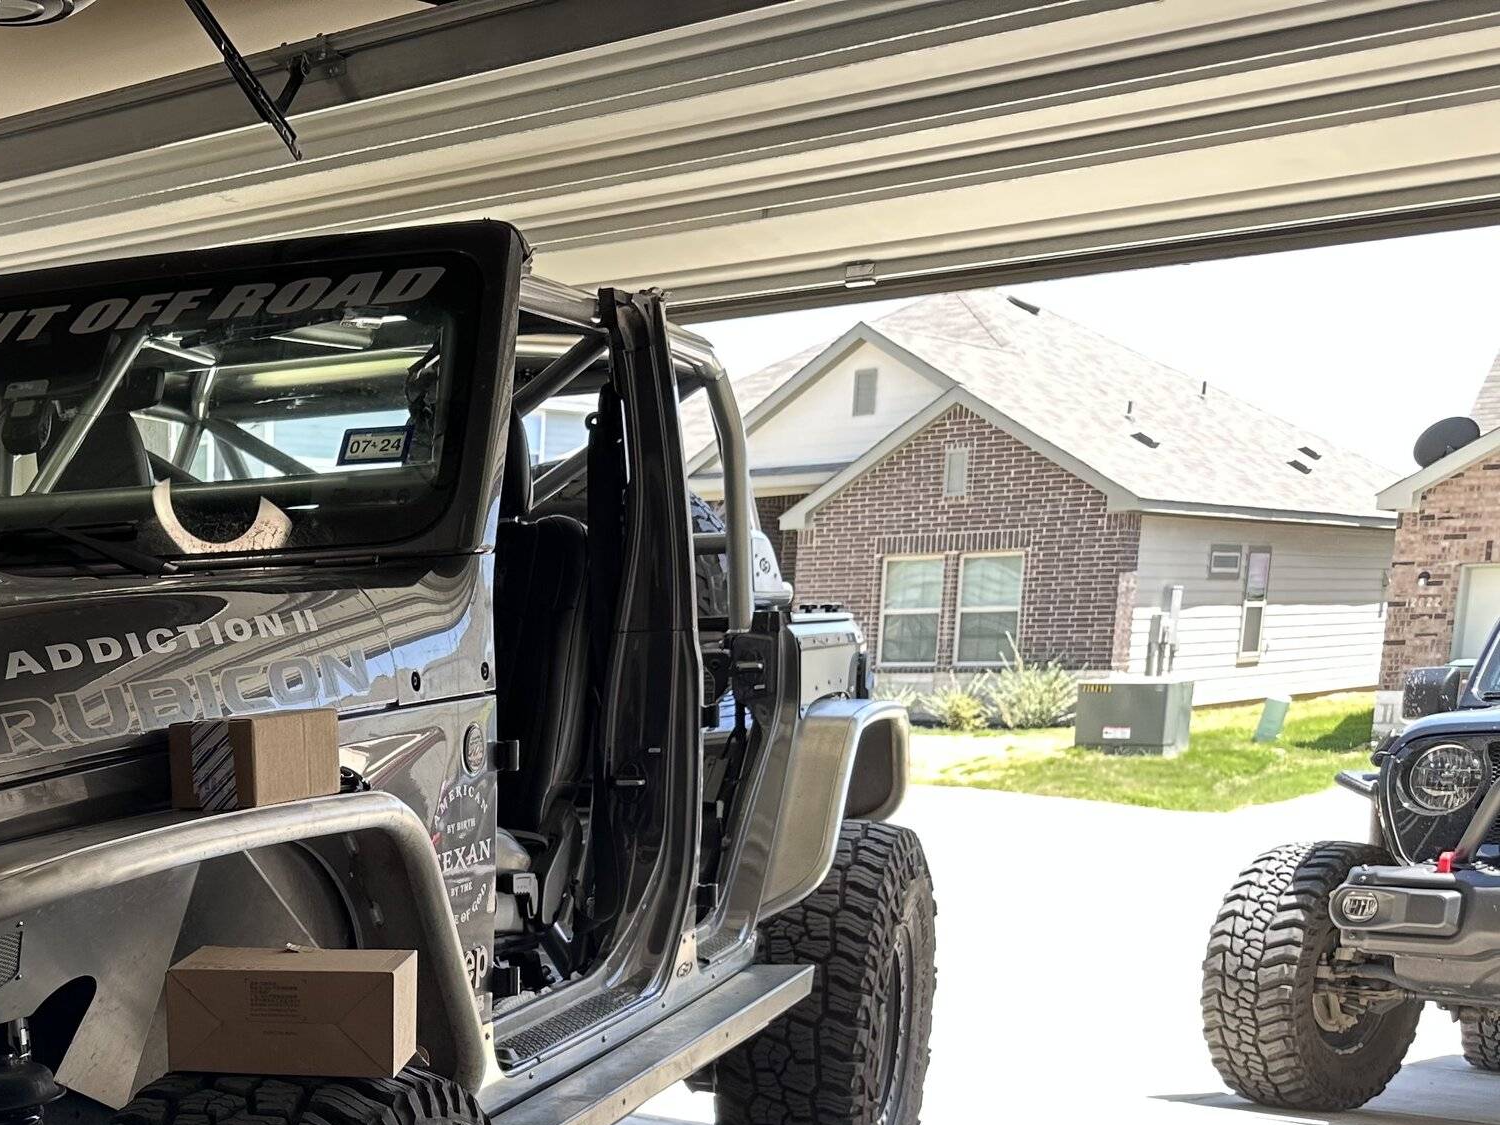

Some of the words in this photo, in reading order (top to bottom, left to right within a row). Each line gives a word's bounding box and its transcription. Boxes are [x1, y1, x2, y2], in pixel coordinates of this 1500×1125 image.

[70, 286, 218, 334] OFF
[202, 265, 448, 317] ROAD
[349, 439, 373, 454] 07
[378, 437, 402, 453] 24
[4, 613, 285, 680] ADDICTION
[433, 784, 489, 830] AMERICAN
[446, 823, 456, 834] BY
[456, 817, 477, 832] BIRTH
[450, 886, 460, 897] BY
[464, 945, 489, 989] ep
